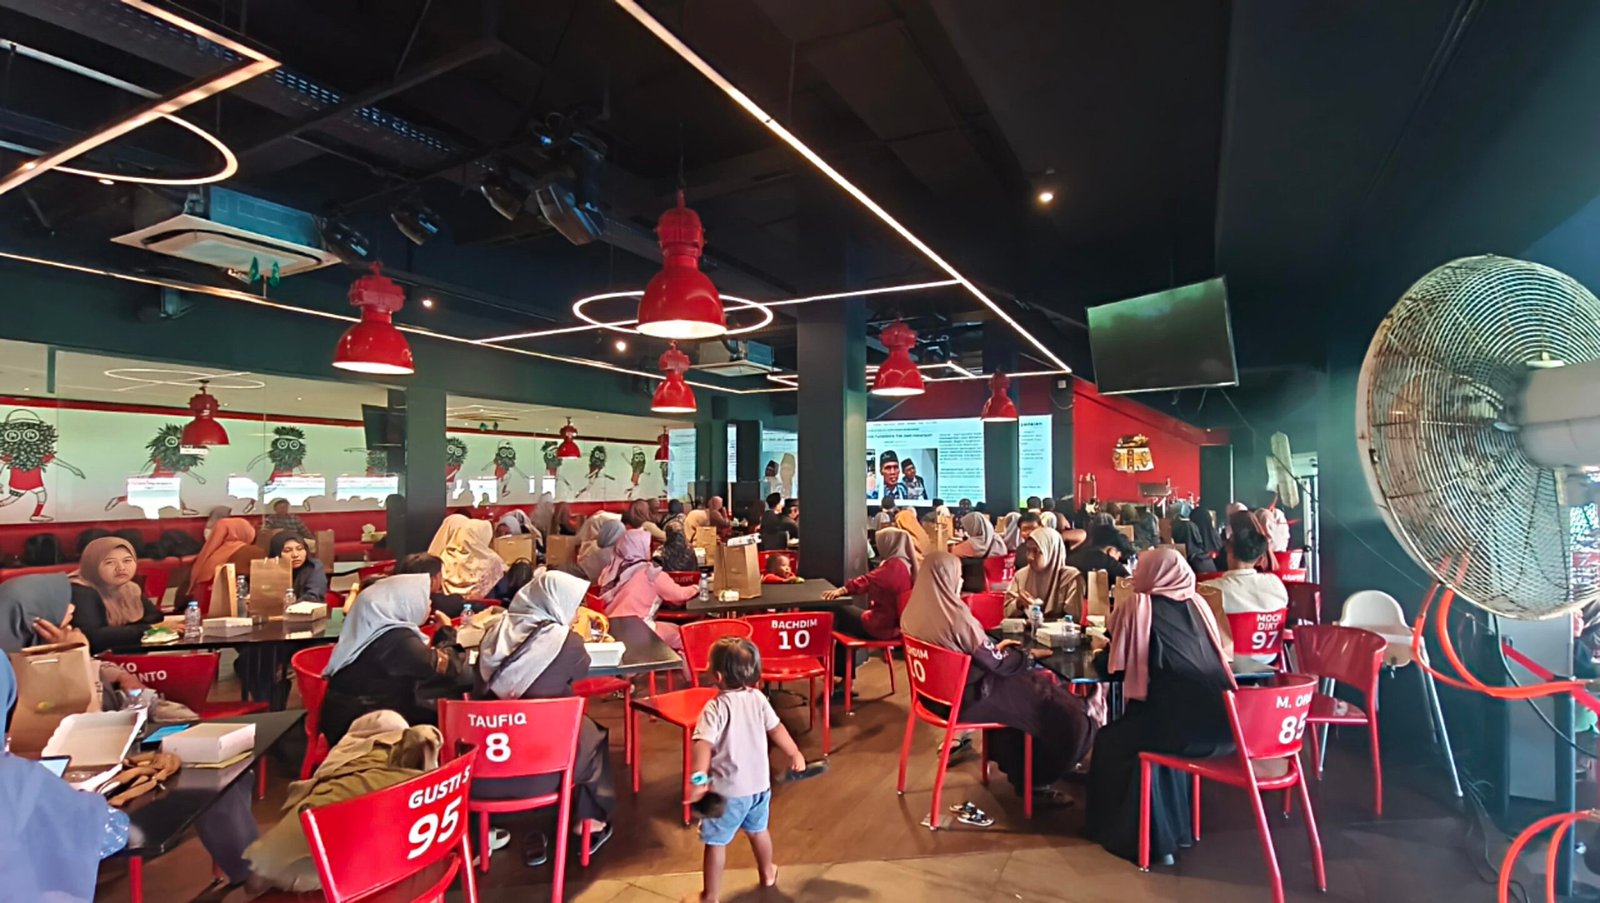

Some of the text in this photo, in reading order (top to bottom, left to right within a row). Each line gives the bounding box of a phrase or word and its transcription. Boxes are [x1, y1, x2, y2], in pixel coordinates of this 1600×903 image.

[771, 618, 818, 630] BACHDIM
[778, 629, 811, 650] 10
[1251, 631, 1279, 650] 97
[139, 669, 167, 683] NTO
[1275, 695, 1292, 709] M.
[467, 712, 527, 728] TAUFIQ
[1278, 711, 1307, 744] 85
[485, 732, 512, 763] 8
[408, 773, 462, 809] GUSTI
[407, 796, 463, 860] 95
